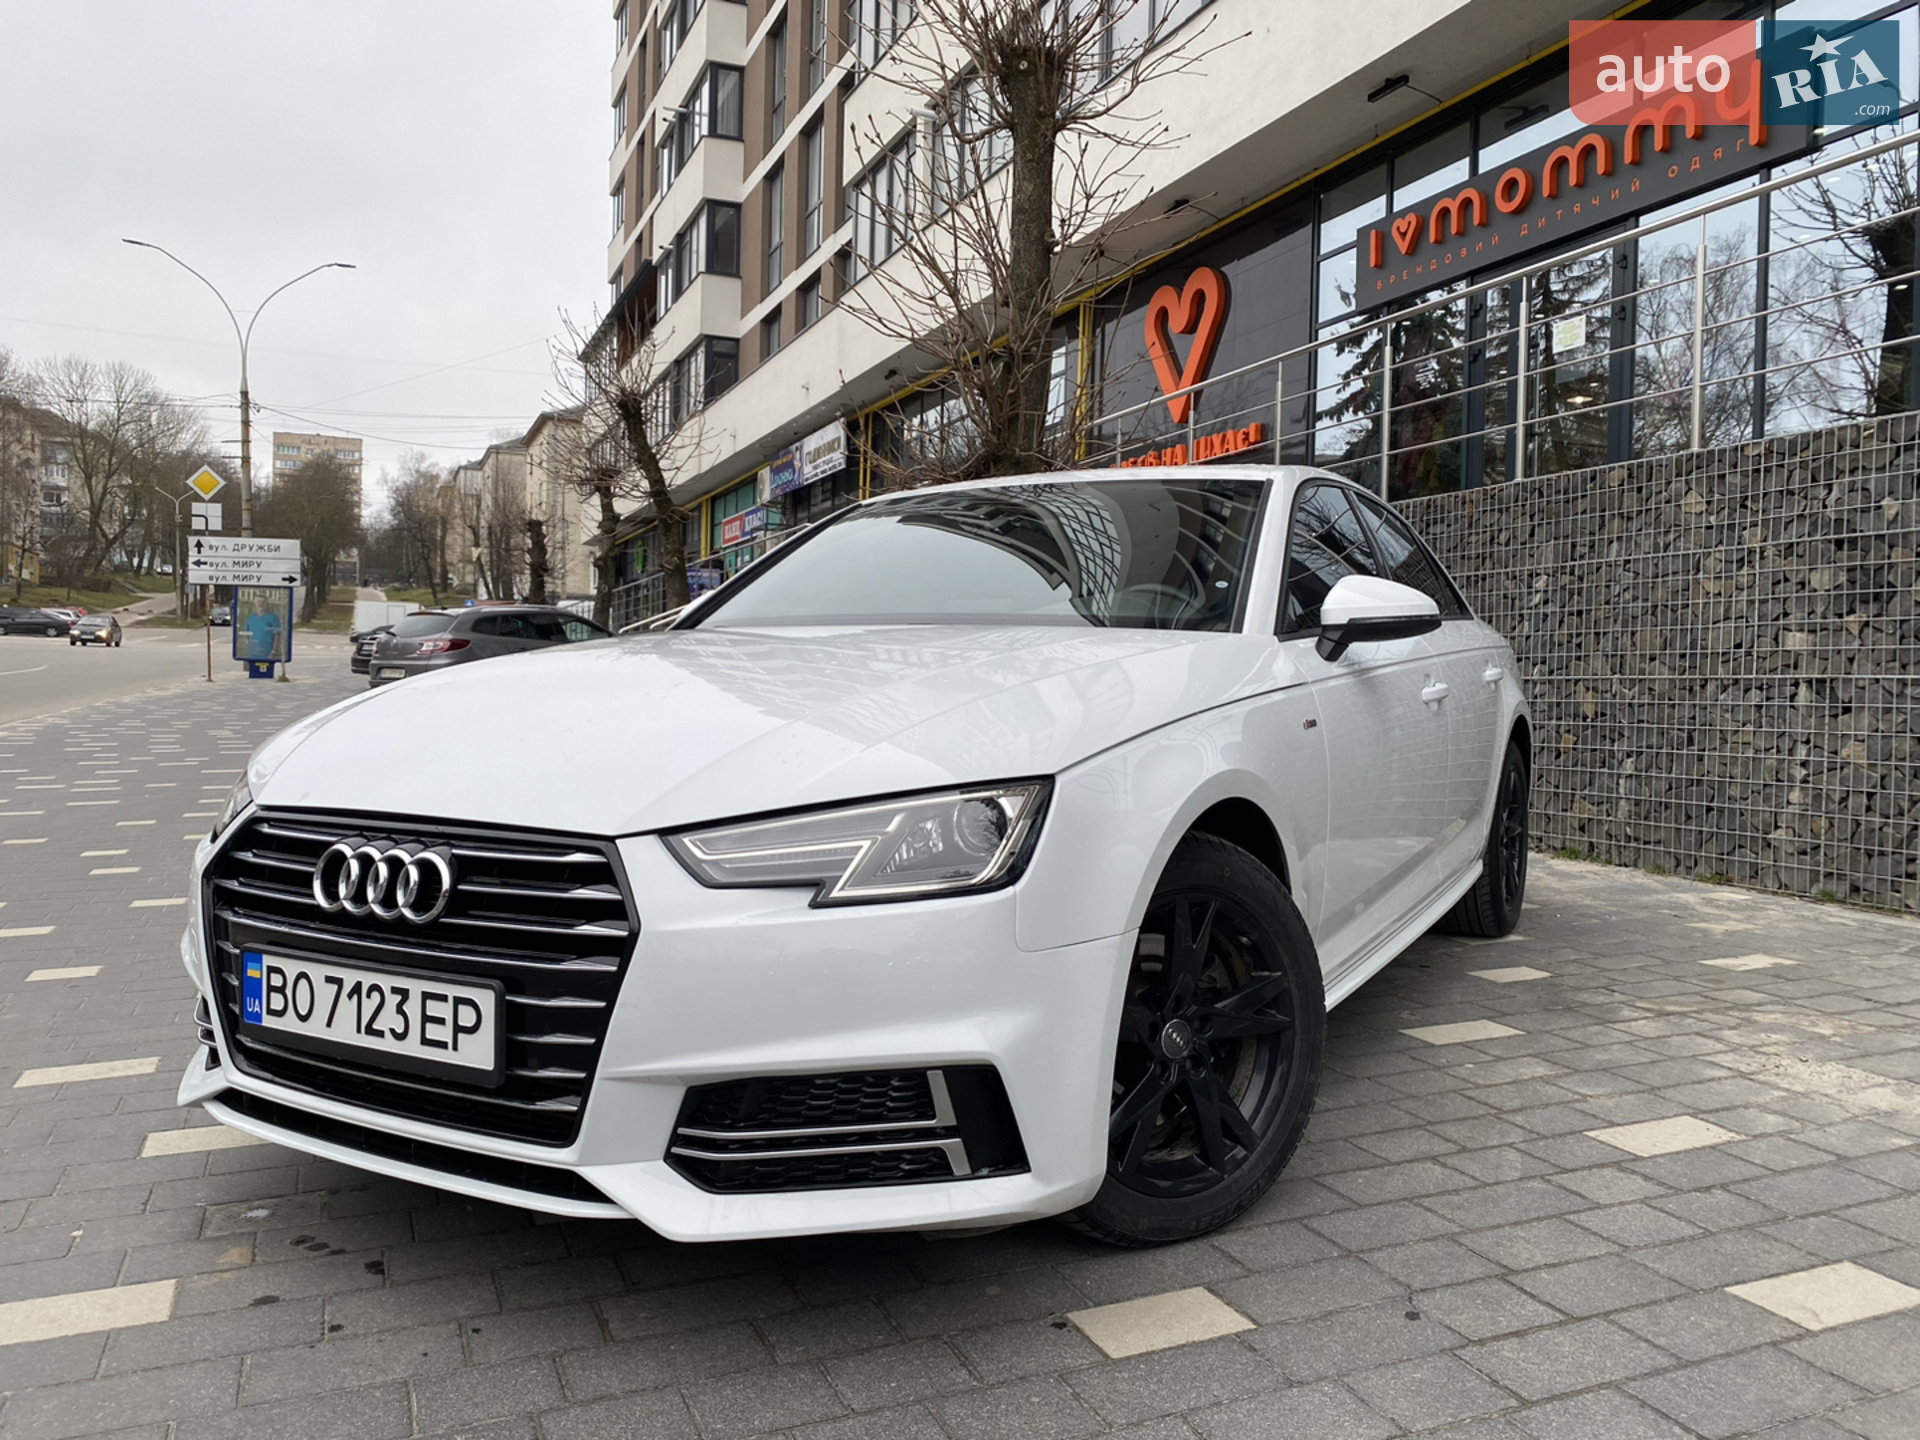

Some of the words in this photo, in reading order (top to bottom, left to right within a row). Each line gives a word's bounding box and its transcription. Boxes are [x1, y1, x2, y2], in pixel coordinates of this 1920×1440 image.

[1376, 232, 1500, 290] БРЕНДОВИЙ
[1519, 177, 1641, 238] ДИТЯЧИЙ
[1667, 137, 1745, 179] ОДЯГ
[208, 544, 229, 553] вул.
[232, 543, 281, 553] ДРУЖБИ
[208, 561, 229, 570] вул.
[232, 560, 262, 569] МИРУ
[208, 575, 229, 584] вул.
[232, 574, 262, 583] МИРУ
[246, 996, 262, 1015] UA
[324, 974, 411, 1042] 7123
